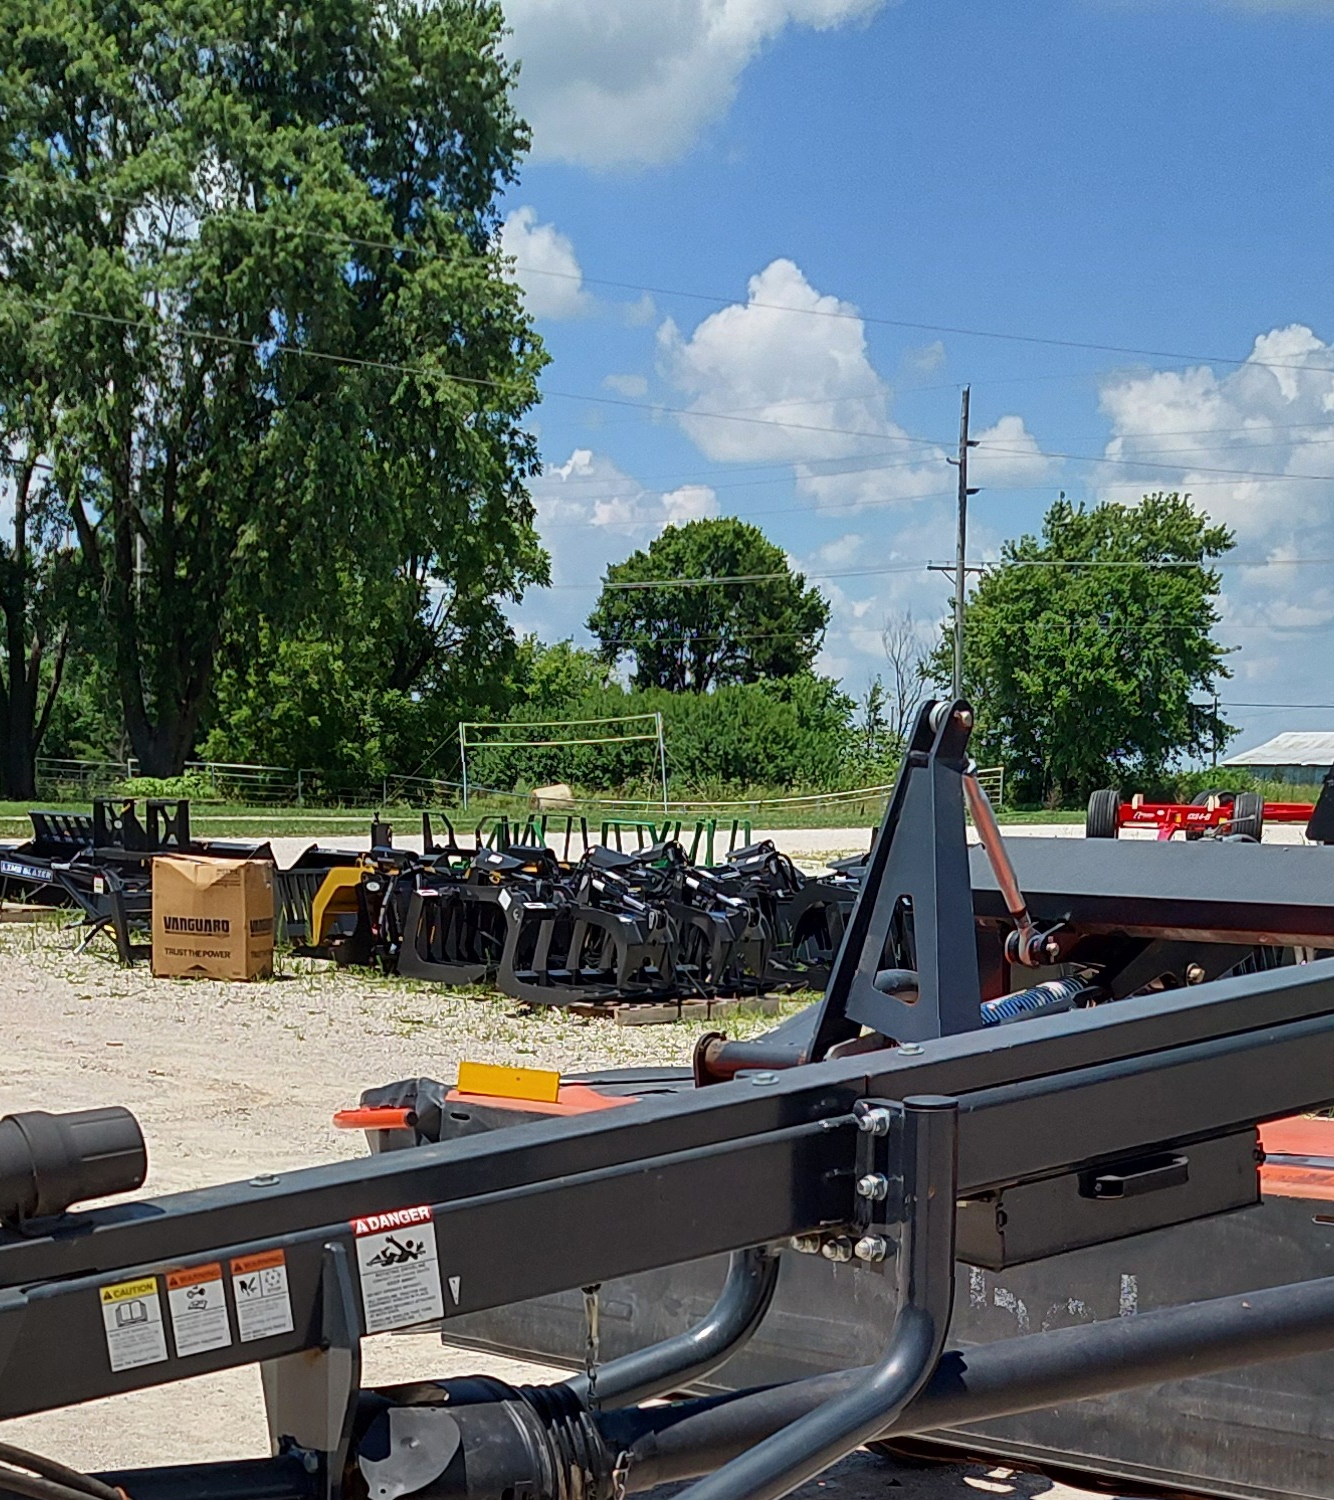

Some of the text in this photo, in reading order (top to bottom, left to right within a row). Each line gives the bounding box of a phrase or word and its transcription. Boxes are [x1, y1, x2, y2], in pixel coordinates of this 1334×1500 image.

[164, 916, 229, 932] VANGUARD
[165, 947, 231, 958] TRUST THE POWER
[367, 1206, 431, 1231] DANGER
[113, 1283, 154, 1298] CAUTION
